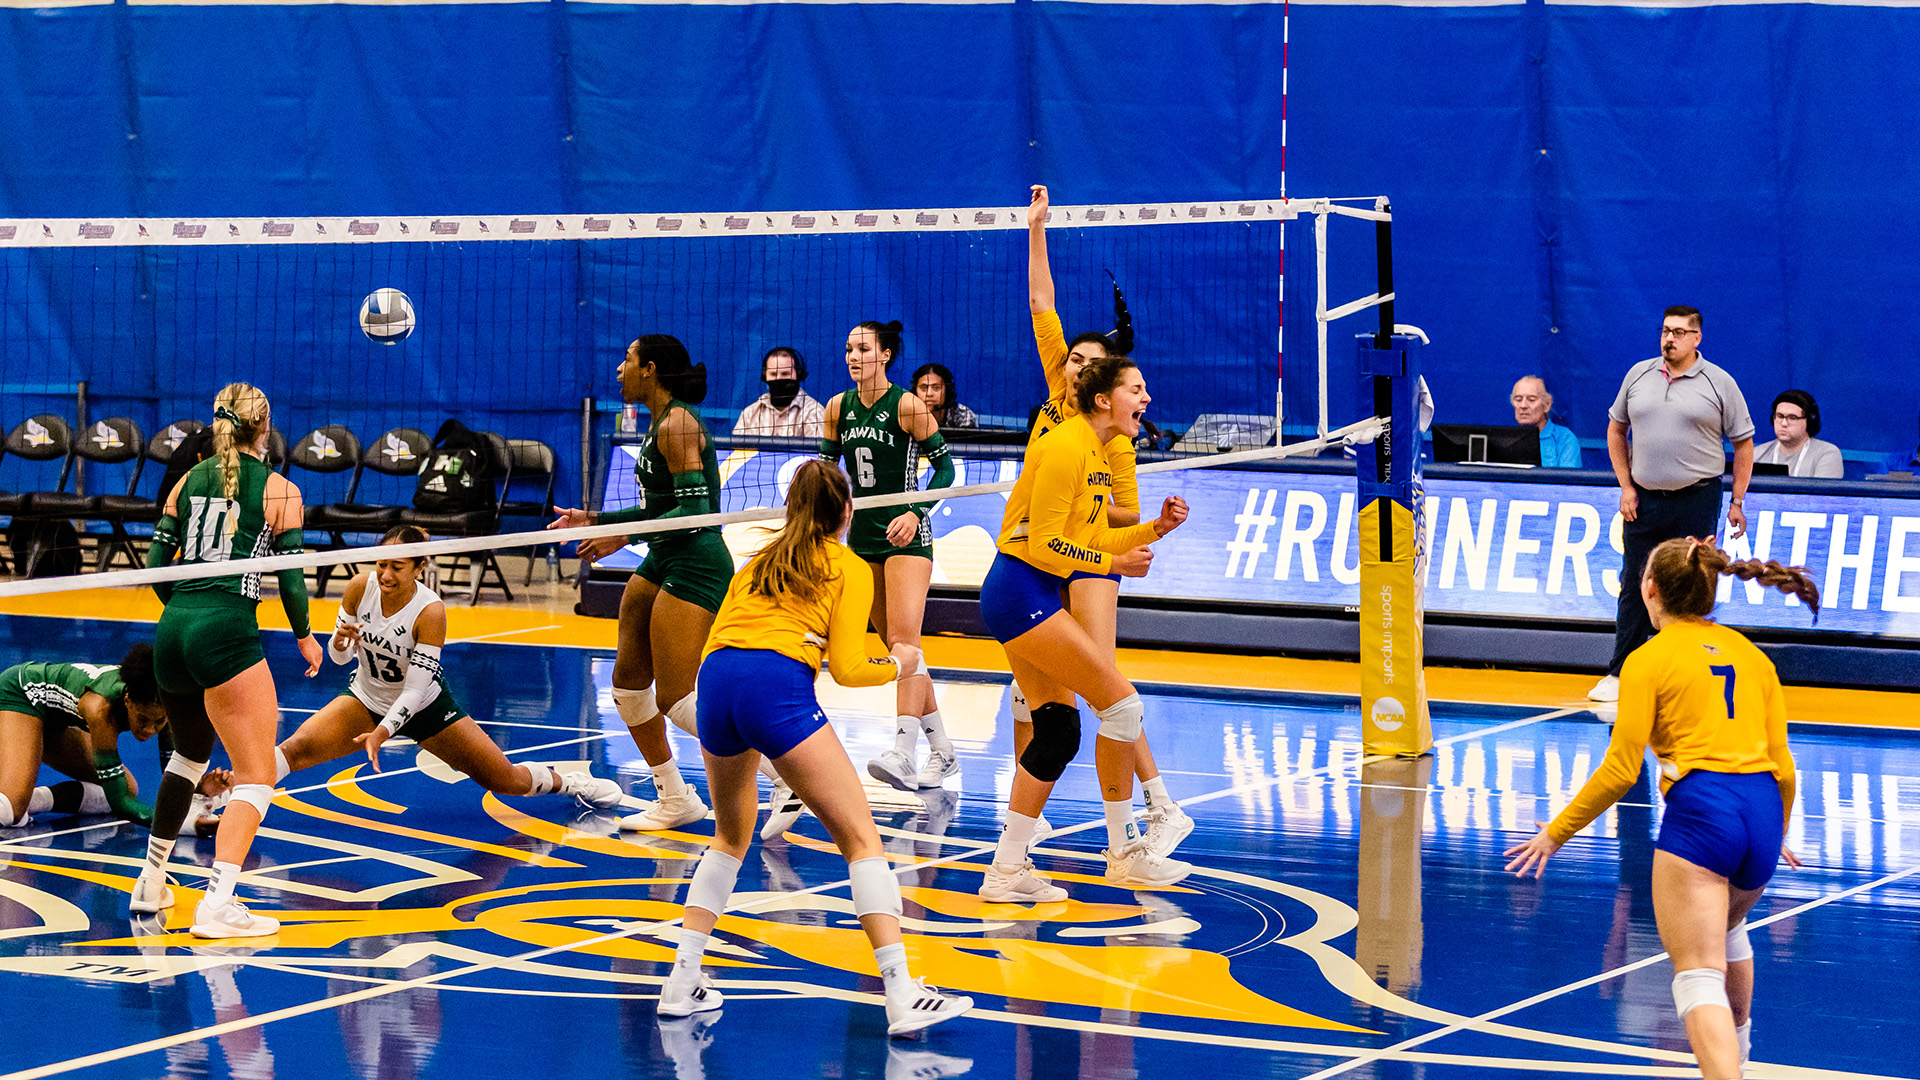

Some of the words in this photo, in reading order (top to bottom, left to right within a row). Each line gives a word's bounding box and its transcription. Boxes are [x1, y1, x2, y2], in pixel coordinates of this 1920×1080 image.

[855, 447, 876, 488] 6
[1086, 494, 1104, 524] 17
[184, 496, 241, 562] 10
[1047, 537, 1102, 564] RUNNERS
[1380, 585, 1392, 629] sports
[361, 631, 412, 659] AWAI'I
[1381, 631, 1395, 685] imports
[363, 646, 404, 683] 13
[1708, 664, 1736, 720] 7
[1375, 712, 1405, 722] NCAA
[64, 962, 160, 977] TM
